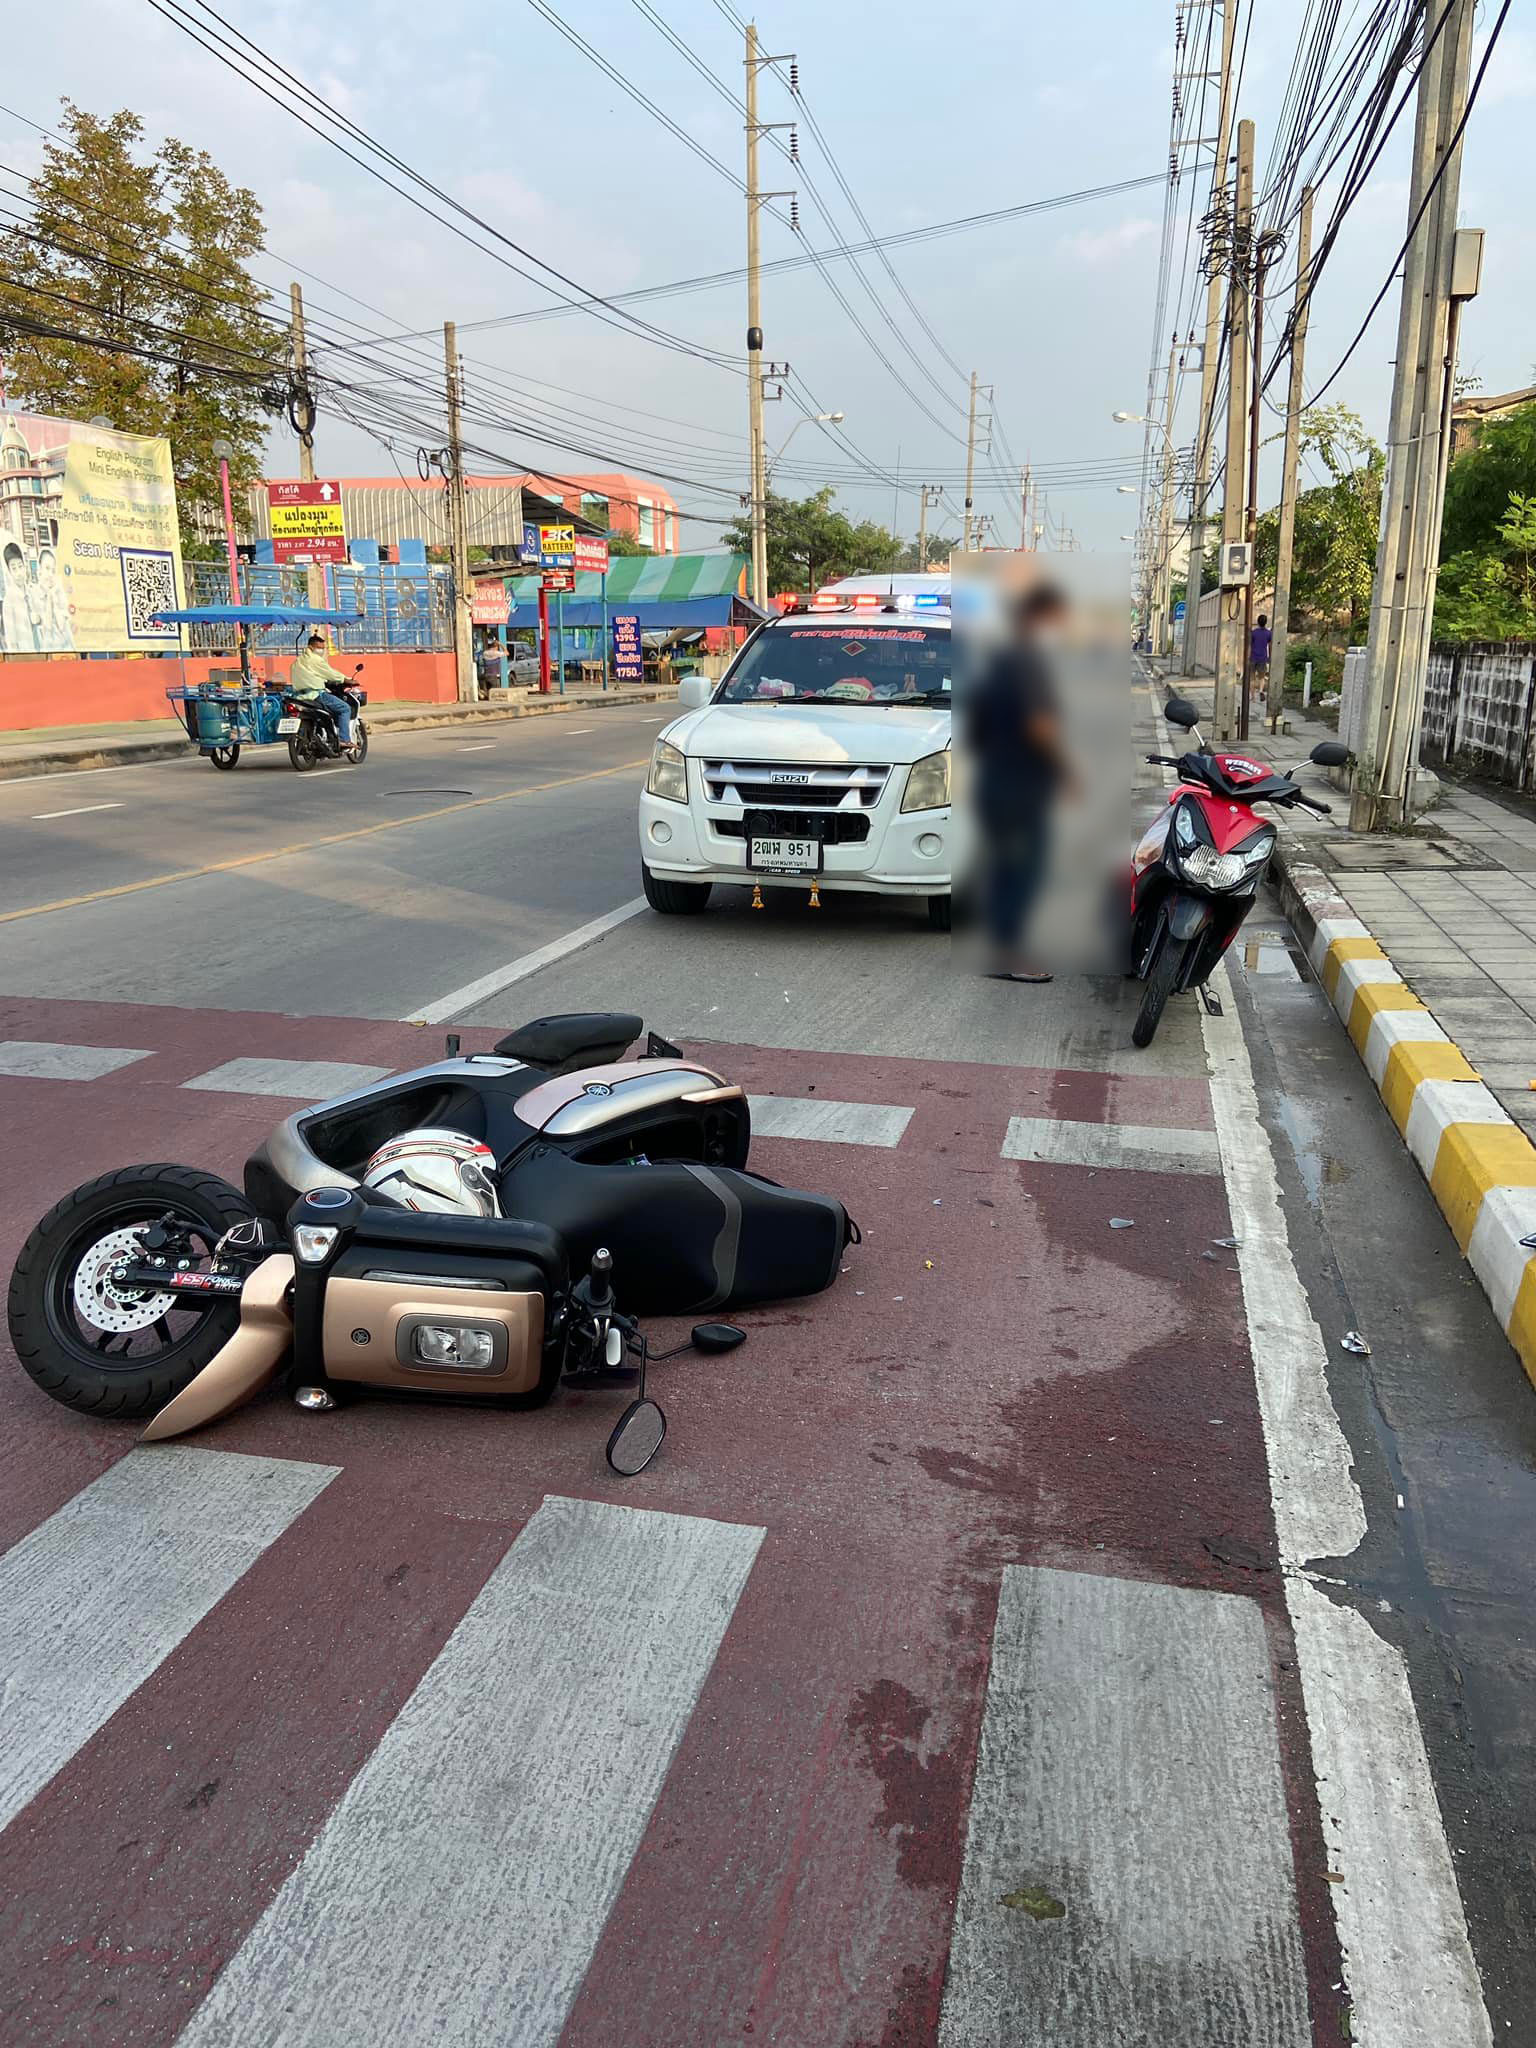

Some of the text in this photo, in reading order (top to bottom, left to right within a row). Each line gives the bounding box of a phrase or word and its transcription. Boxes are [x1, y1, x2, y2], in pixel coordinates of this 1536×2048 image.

[96, 447, 154, 467] English Program
[88, 461, 163, 485] Mini English Program
[285, 507, 328, 524] แปลงมุม
[272, 521, 343, 536] ห้องนอนใหญ่ทุกห้อง
[543, 529, 573, 541] 3K
[73, 537, 101, 558] Scan
[307, 538, 326, 548] 2.94
[542, 543, 573, 552] BATTERY
[772, 774, 809, 784] ISUZU
[788, 843, 811, 857] 951
[172, 1272, 205, 1287] YSS
